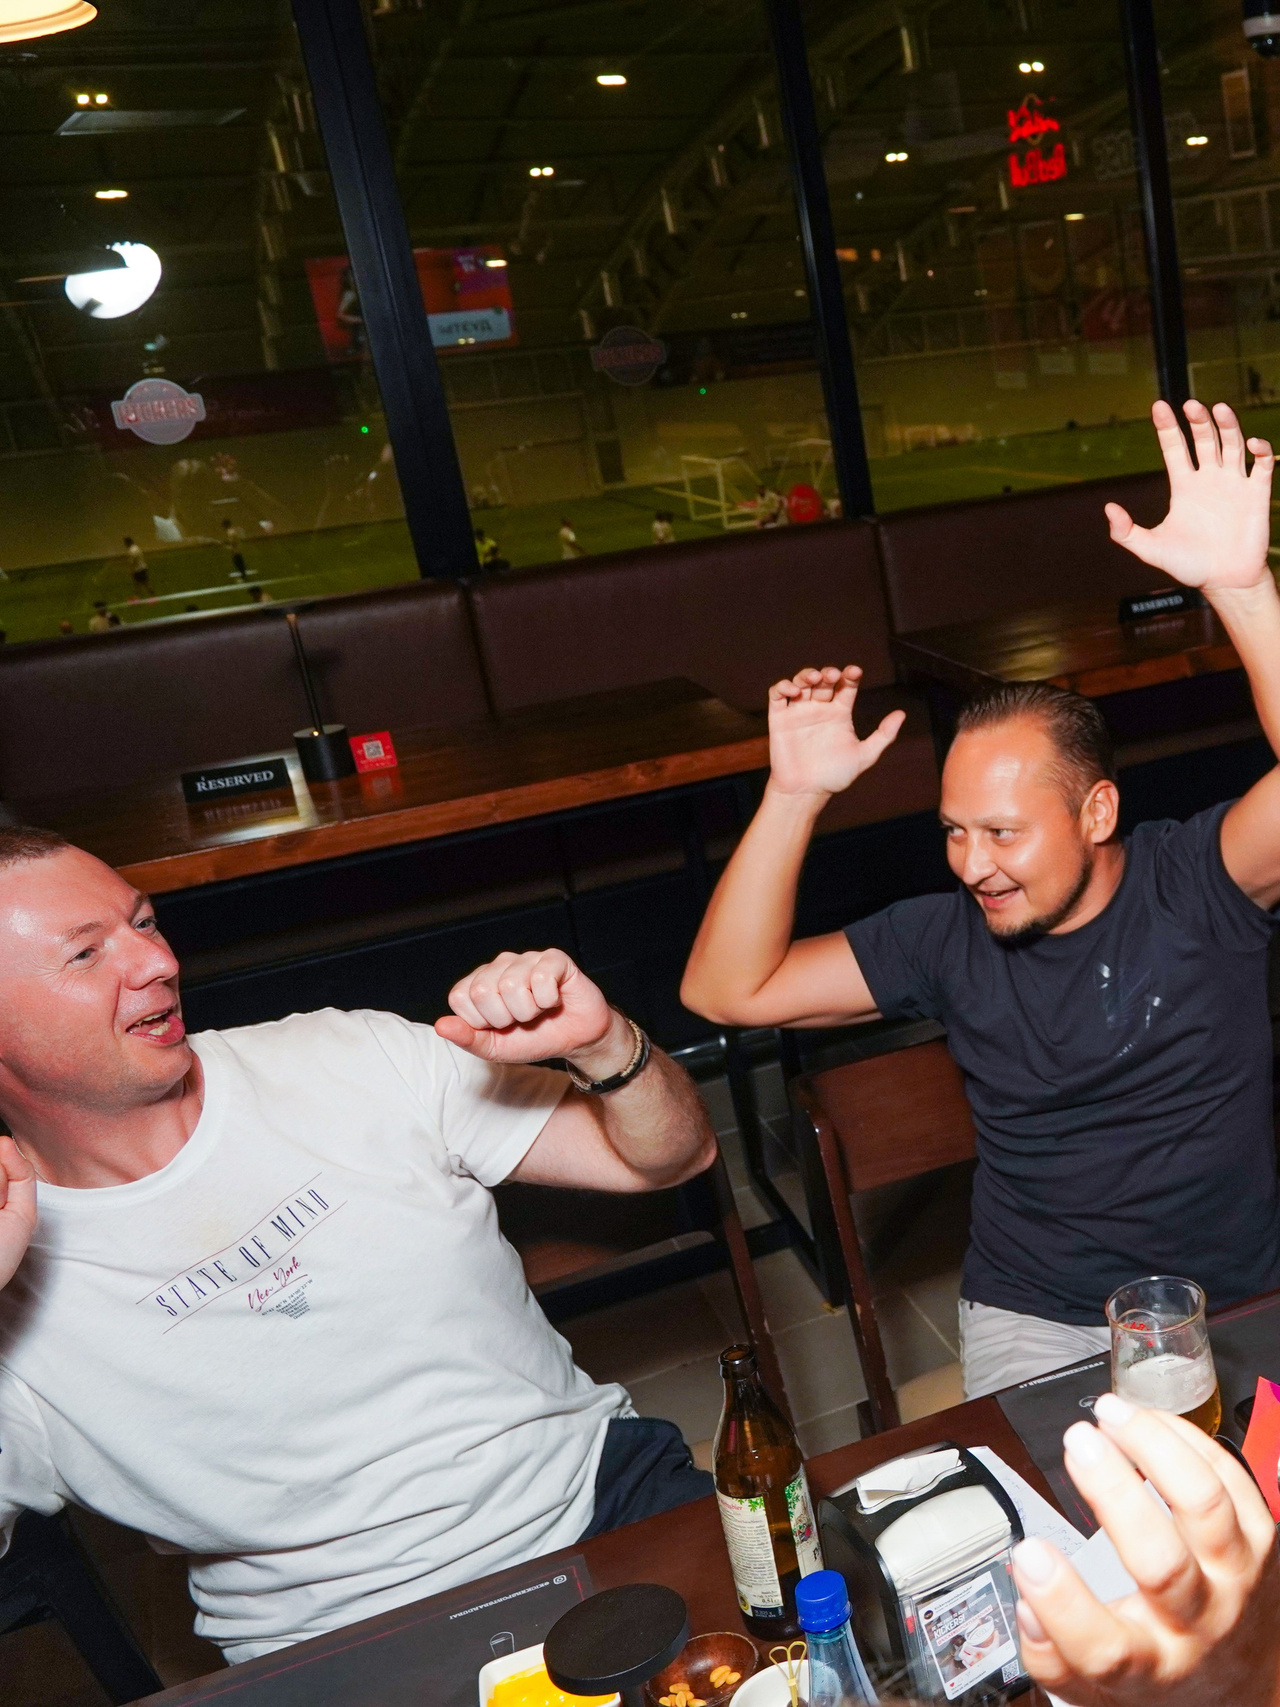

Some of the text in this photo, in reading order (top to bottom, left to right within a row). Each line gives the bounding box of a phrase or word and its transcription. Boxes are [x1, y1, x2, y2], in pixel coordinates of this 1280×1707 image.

[1131, 595, 1184, 614] RESERVED
[196, 770, 275, 793] RESERVED
[155, 1189, 330, 1317] STATE OF MIND
[273, 1256, 301, 1289] York
[933, 1613, 965, 1639] KICKERS!
